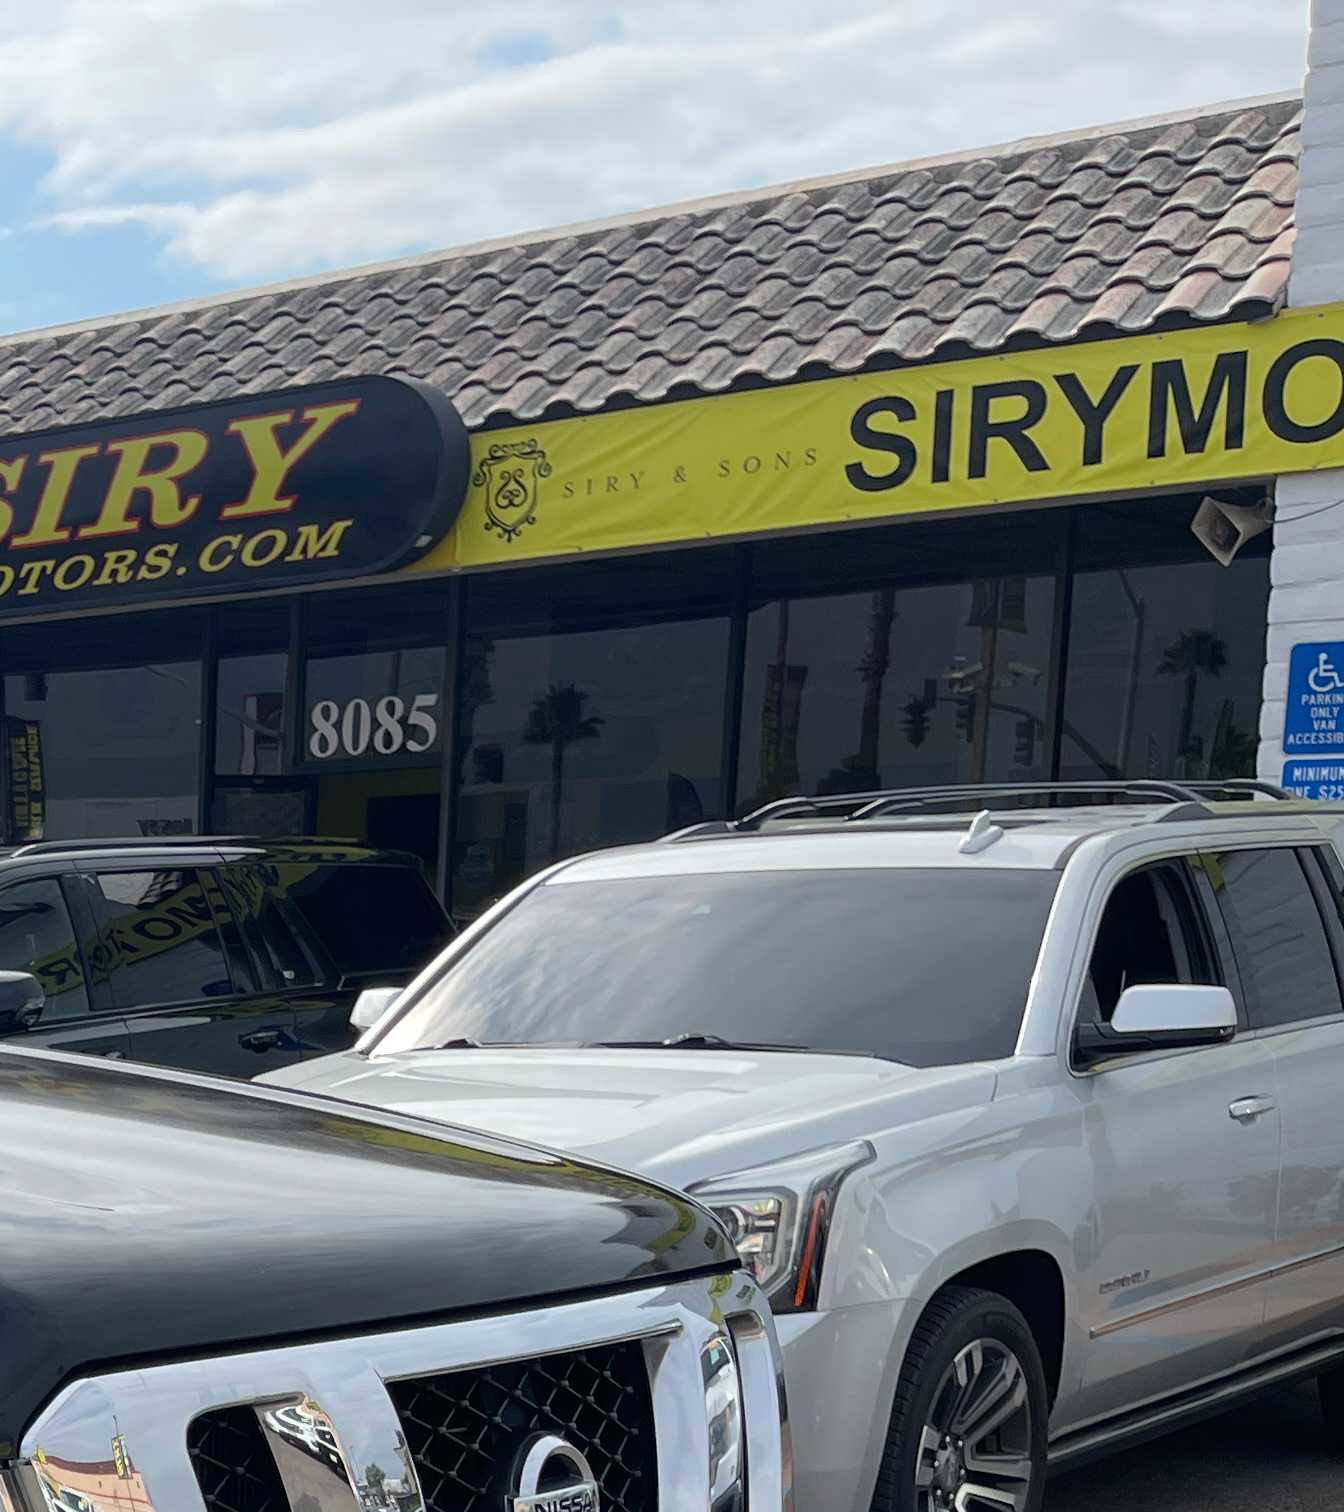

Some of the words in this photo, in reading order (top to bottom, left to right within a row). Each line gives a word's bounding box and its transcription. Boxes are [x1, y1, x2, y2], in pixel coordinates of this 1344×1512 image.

[562, 471, 644, 498] SIRY
[673, 465, 687, 483] &
[718, 447, 817, 478] SONS
[310, 693, 438, 759] 8085
[1310, 707, 1340, 718] ONLY
[1313, 720, 1336, 731] VAN
